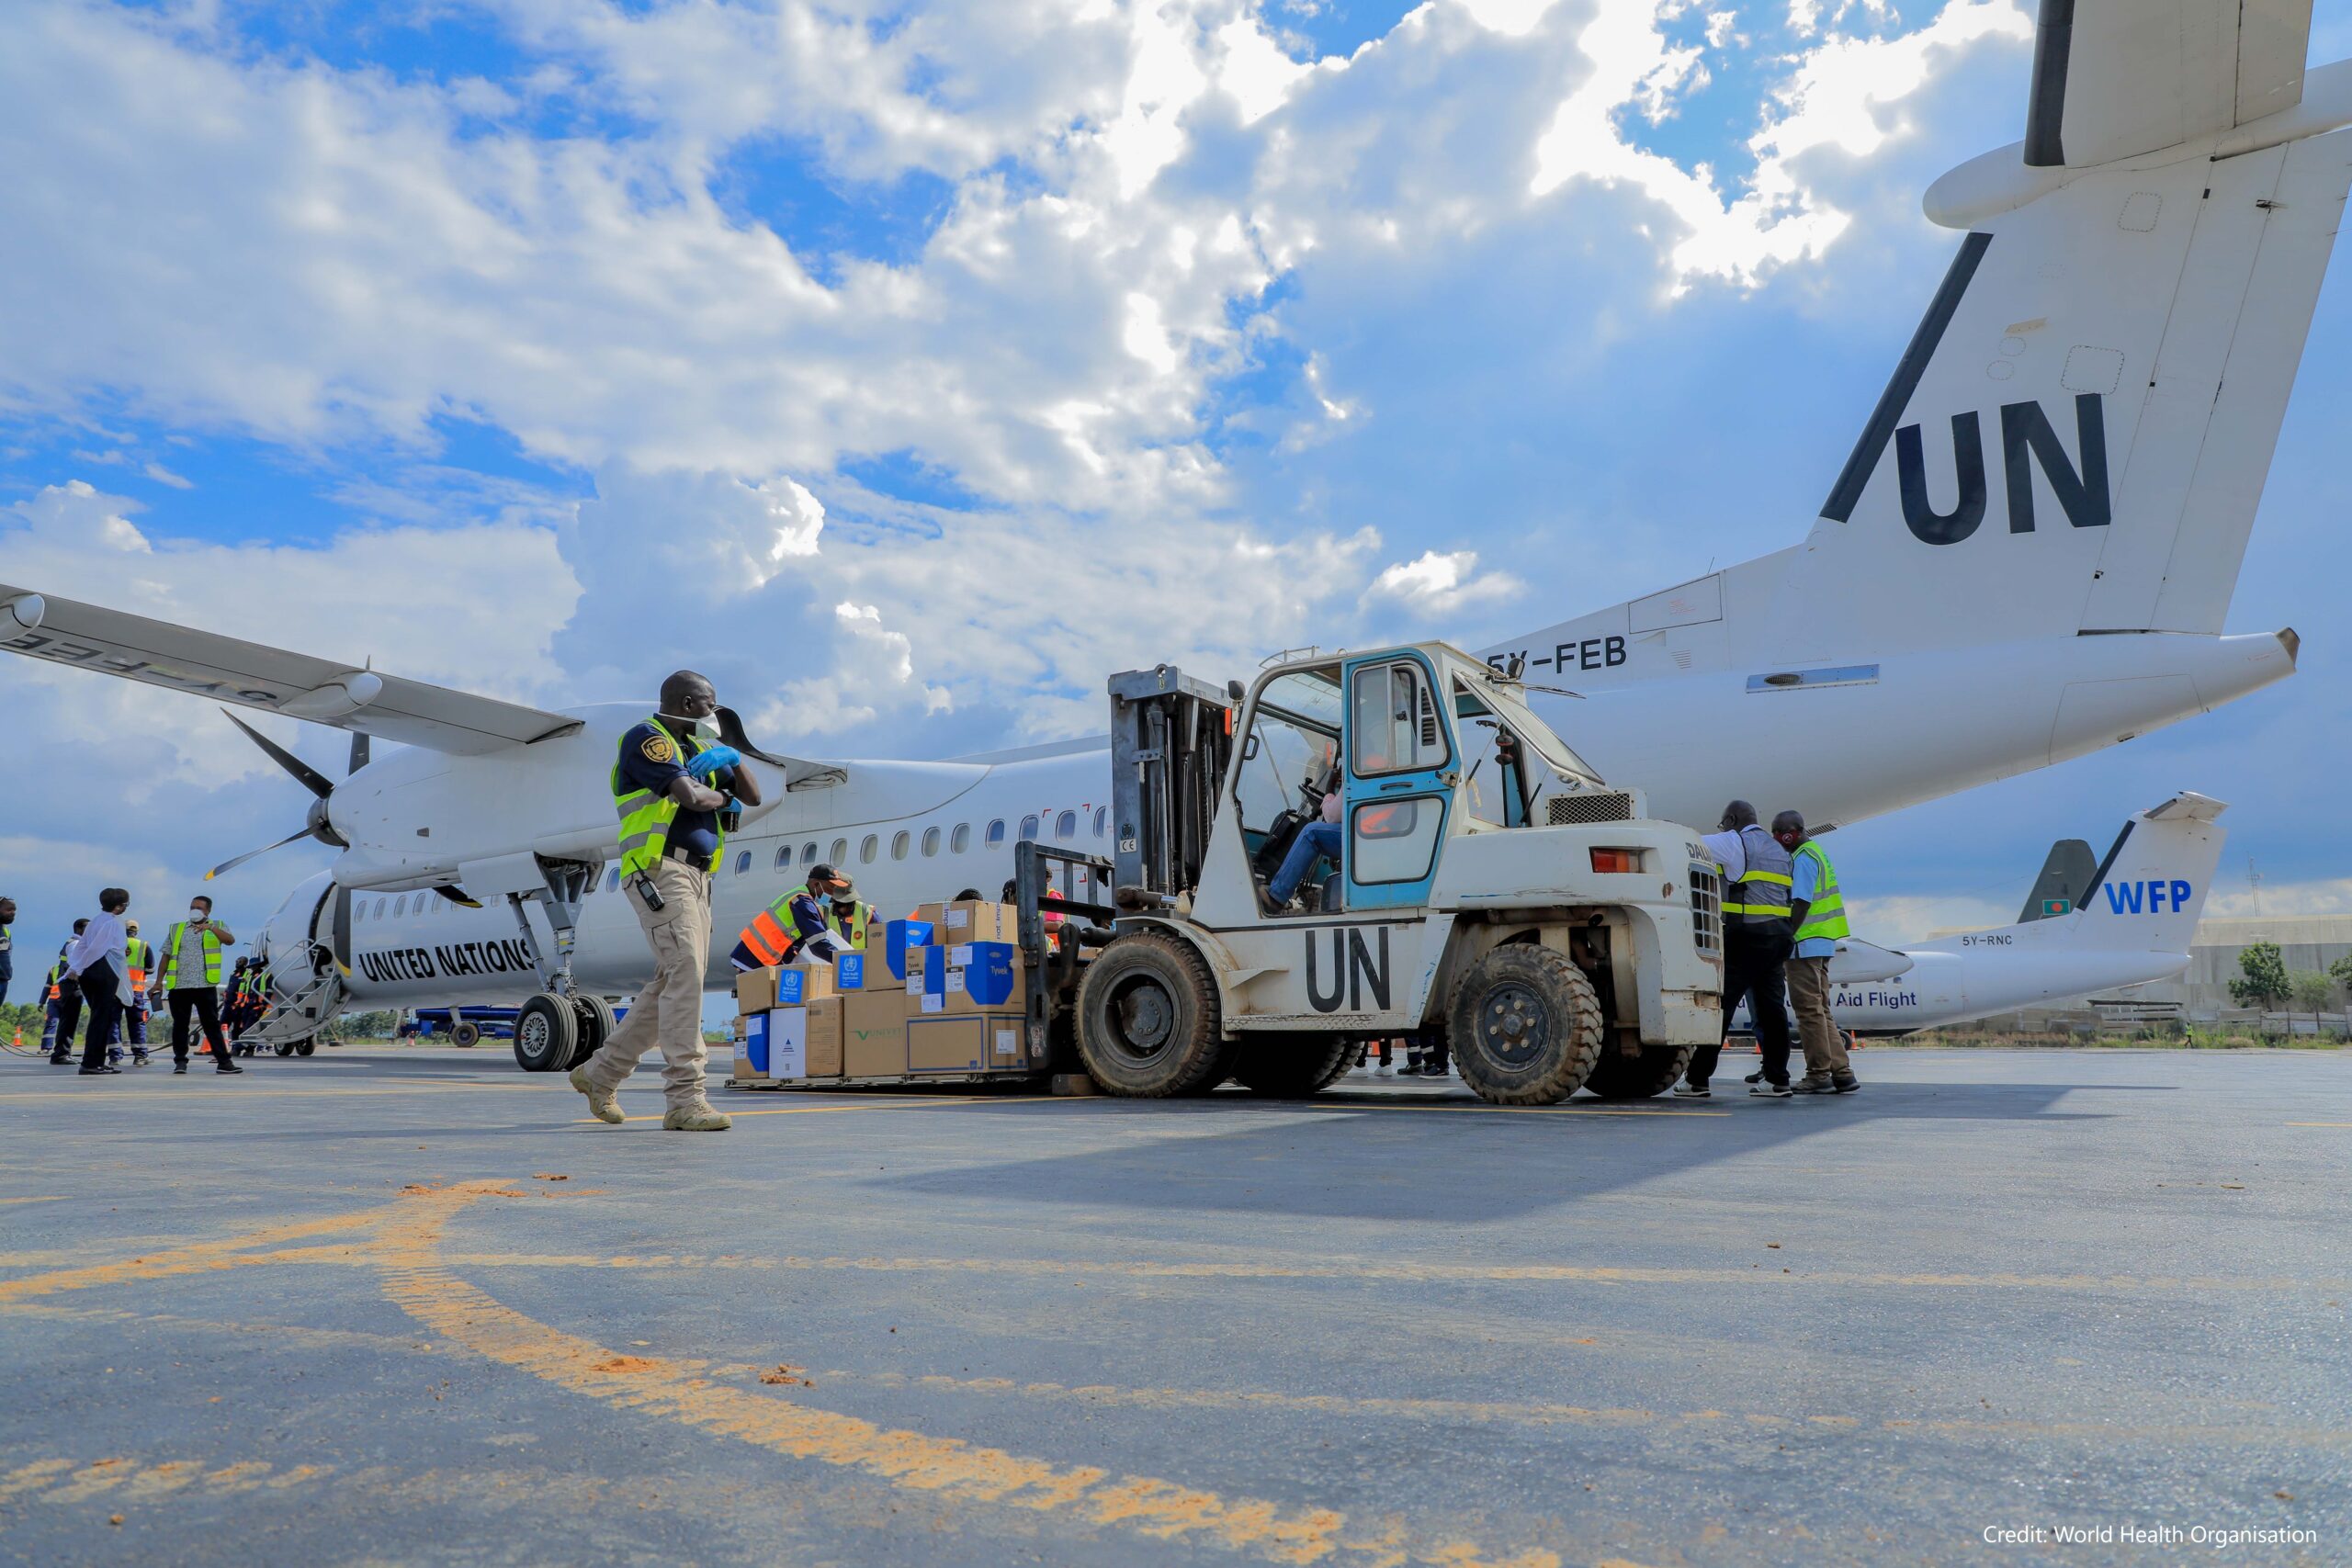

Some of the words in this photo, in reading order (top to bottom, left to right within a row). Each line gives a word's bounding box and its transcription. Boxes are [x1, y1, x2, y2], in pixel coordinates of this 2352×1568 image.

[1895, 393, 2111, 545] UN
[2104, 880, 2192, 915] WFP
[1962, 935, 2013, 946] 5Y-RNC
[358, 947, 435, 982] UNITED
[435, 938, 536, 976] NATIONS
[990, 965, 1009, 976] Tyvek
[1306, 926, 1391, 1013] UN
[1836, 992, 1862, 1007] Aid
[1869, 992, 1917, 1010] Flight
